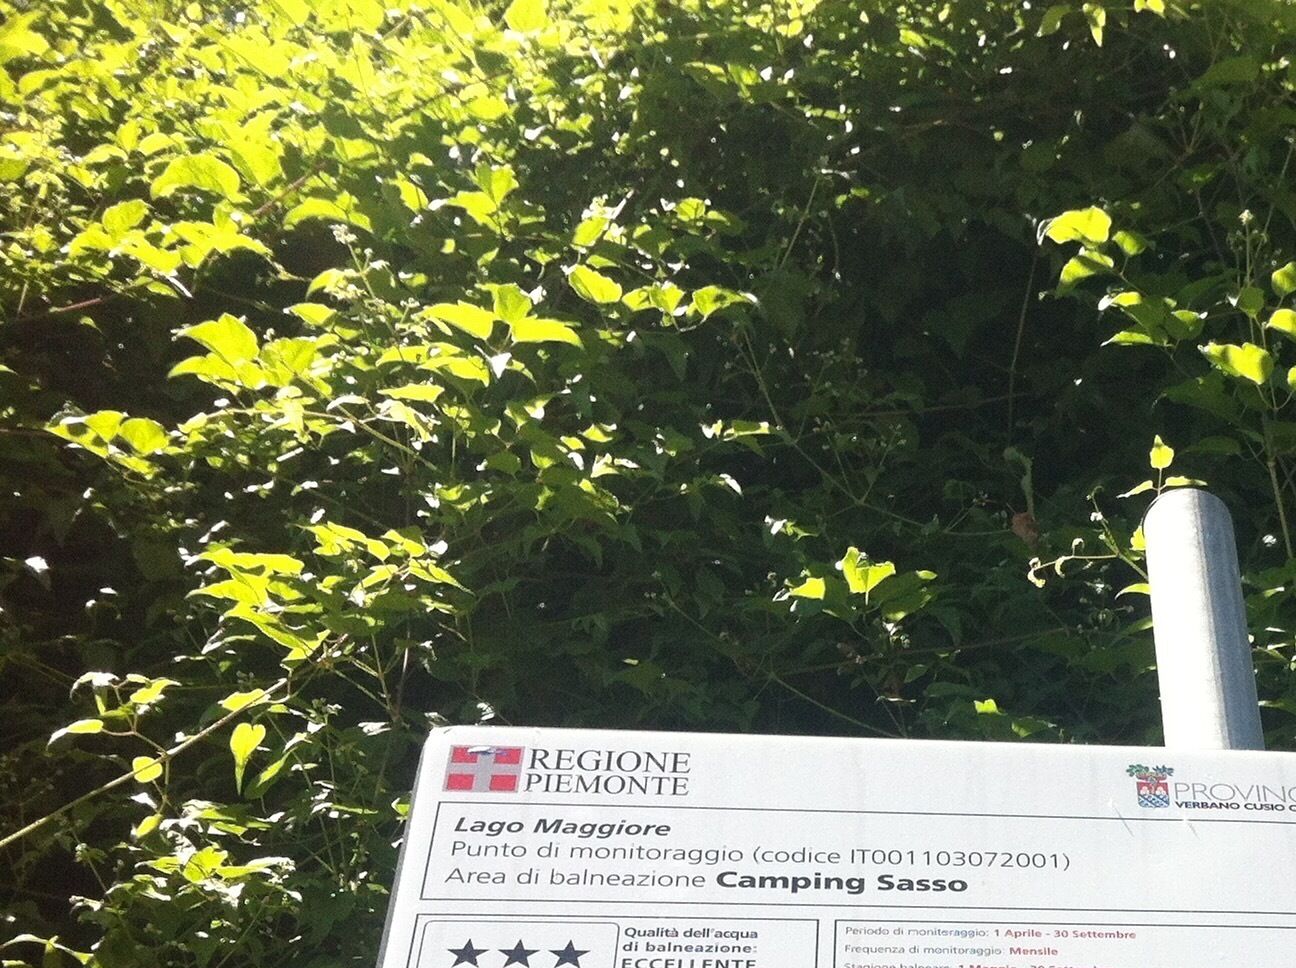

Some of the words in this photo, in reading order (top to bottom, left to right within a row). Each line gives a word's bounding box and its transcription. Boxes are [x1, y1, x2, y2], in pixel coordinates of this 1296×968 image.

[528, 748, 691, 774] REGIONE
[524, 773, 689, 796] PIEMONTE
[1174, 800, 1241, 810] VERBANO
[1243, 802, 1286, 812] CUSIO
[454, 817, 525, 837] Lago
[533, 818, 671, 839] Maggiore
[451, 840, 527, 858] Punto
[536, 841, 559, 858] di
[569, 845, 744, 866] monitoraggio
[753, 846, 841, 864] (codice
[850, 848, 1070, 872] IT001103072001)
[444, 867, 506, 885] Area
[516, 867, 539, 885] di
[549, 868, 707, 888] balneazione
[716, 870, 867, 896] Camping
[877, 874, 969, 892] Sasso
[624, 927, 679, 939] Qualità
[845, 926, 890, 936] Periodo
[892, 927, 904, 936] di
[994, 928, 1000, 937] 1
[1004, 929, 1042, 939] Aprile
[1054, 929, 1069, 938] 30
[1072, 930, 1137, 939] Settembre
[622, 941, 639, 952] di
[645, 941, 757, 954] balneazione:
[844, 944, 906, 955] Frequenza
[908, 945, 920, 954] di
[1009, 946, 1059, 956] Mensile
